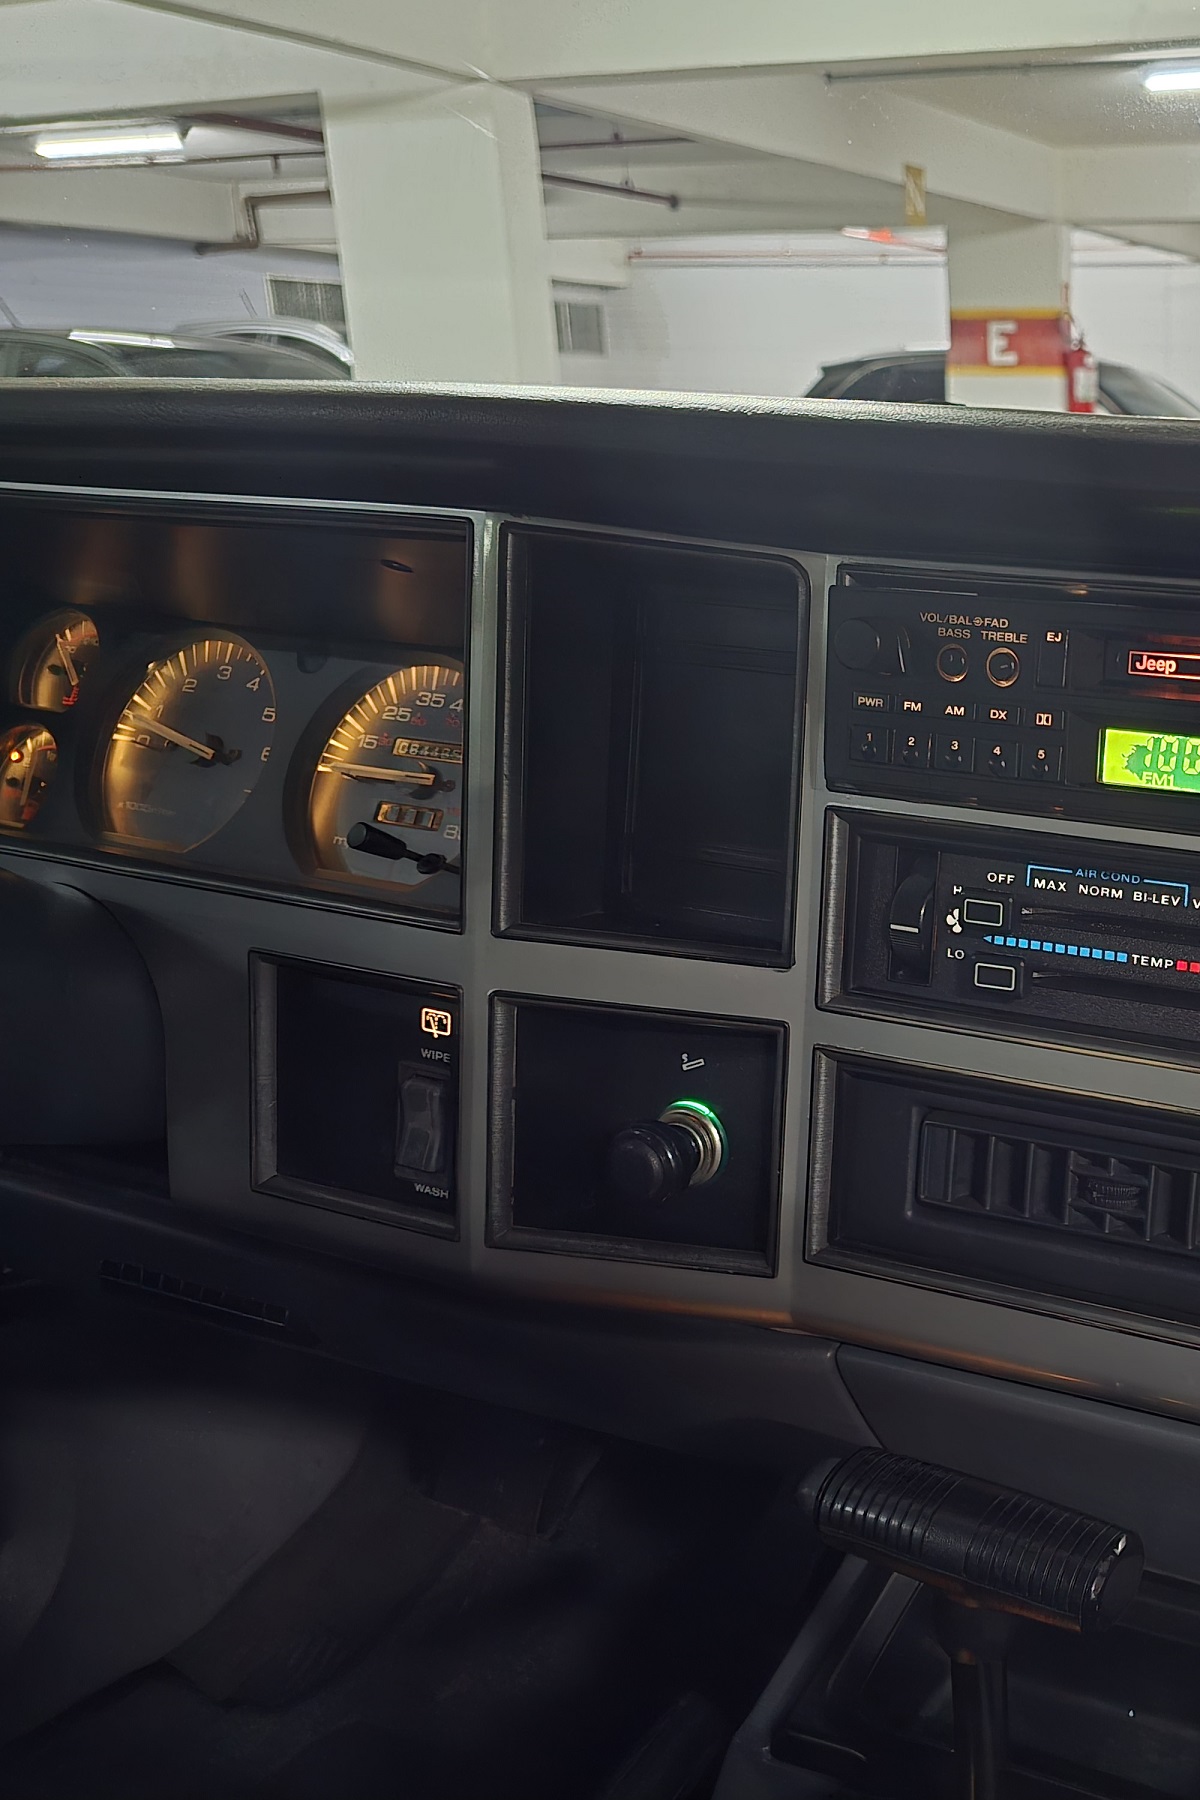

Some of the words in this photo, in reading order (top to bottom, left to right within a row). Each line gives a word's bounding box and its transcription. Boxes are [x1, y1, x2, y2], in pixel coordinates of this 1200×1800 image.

[985, 320, 1018, 367] E
[983, 617, 1009, 629] FAD
[937, 627, 971, 640] BASS
[980, 630, 1029, 645] TREBLE
[1046, 631, 1063, 643] EJ
[216, 665, 233, 680] 3
[1135, 655, 1177, 675] Jeep
[181, 678, 198, 693] 2
[245, 677, 261, 692] 4
[415, 691, 447, 708] 35
[448, 698, 464, 713] 4
[857, 696, 884, 708] PWR
[903, 700, 922, 712] FM
[155, 704, 164, 718] 1
[261, 707, 276, 723] 5
[381, 705, 413, 722] 25
[944, 705, 965, 717] AM
[989, 709, 1008, 721] DX
[357, 733, 380, 750] 15
[866, 732, 873, 742] 1
[907, 737, 916, 746] 2
[950, 741, 959, 751] 3
[993, 746, 1002, 756] 4
[1037, 750, 1046, 759] 5
[1074, 868, 1097, 879] AIR
[1100, 871, 1141, 884] COND
[986, 871, 1016, 885] OFF
[1034, 878, 1068, 892] MAX
[1078, 884, 1124, 899] NORM
[1132, 891, 1181, 907] BI-LEV
[947, 948, 965, 960] LO
[1131, 953, 1175, 970] TEMP
[420, 1047, 452, 1064] WIPE
[413, 1182, 450, 1200] WASH
